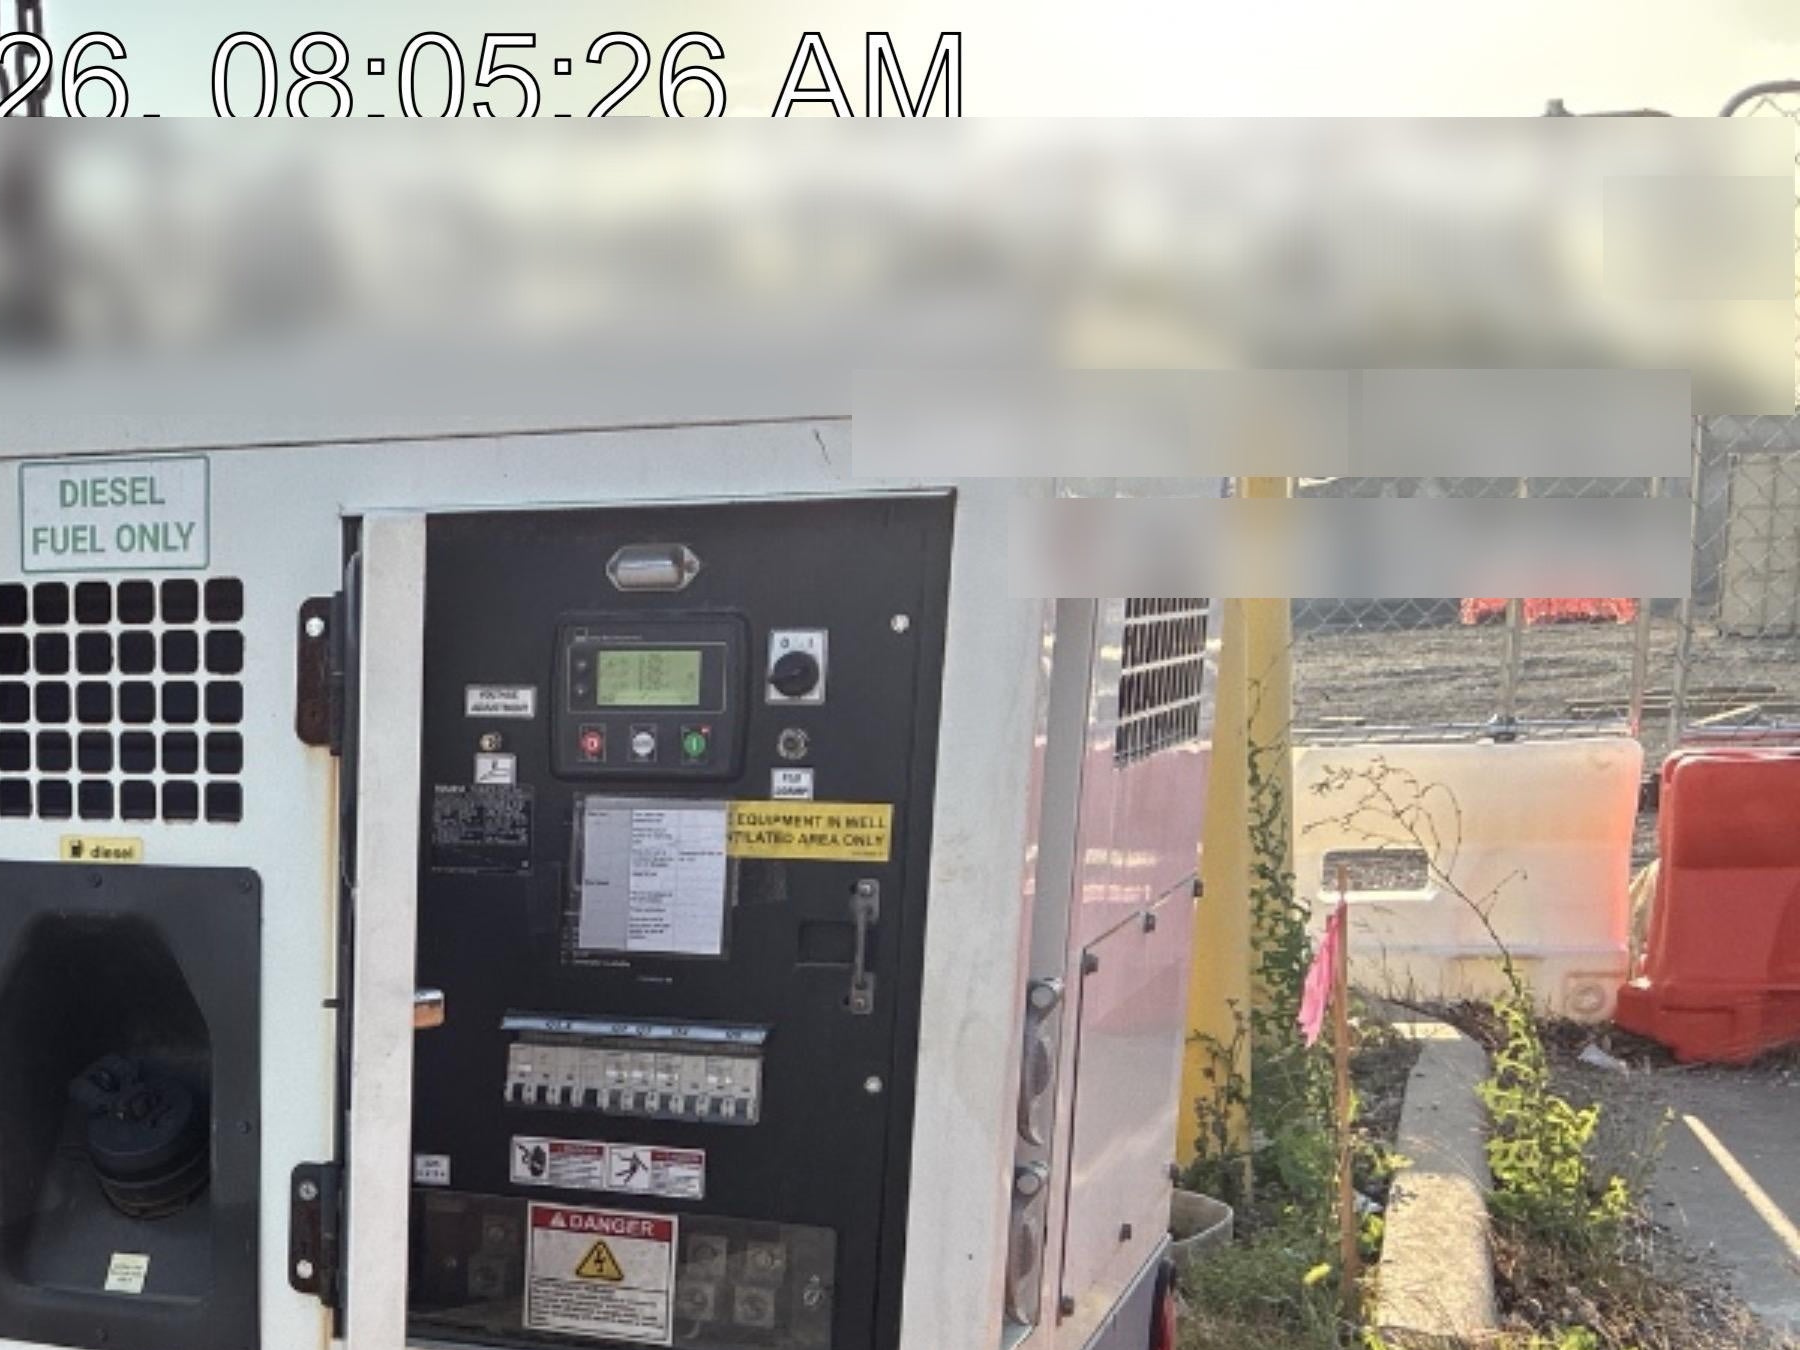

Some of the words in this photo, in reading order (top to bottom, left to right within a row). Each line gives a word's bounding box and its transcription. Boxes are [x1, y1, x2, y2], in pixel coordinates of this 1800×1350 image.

[59, 476, 166, 508] DIESEL
[32, 524, 105, 555] FUEL
[116, 521, 196, 553] ONLY
[737, 812, 823, 828] EQUIPMENT
[827, 814, 841, 829] IN
[89, 845, 134, 859] diesel
[569, 1213, 655, 1237] DANGER
